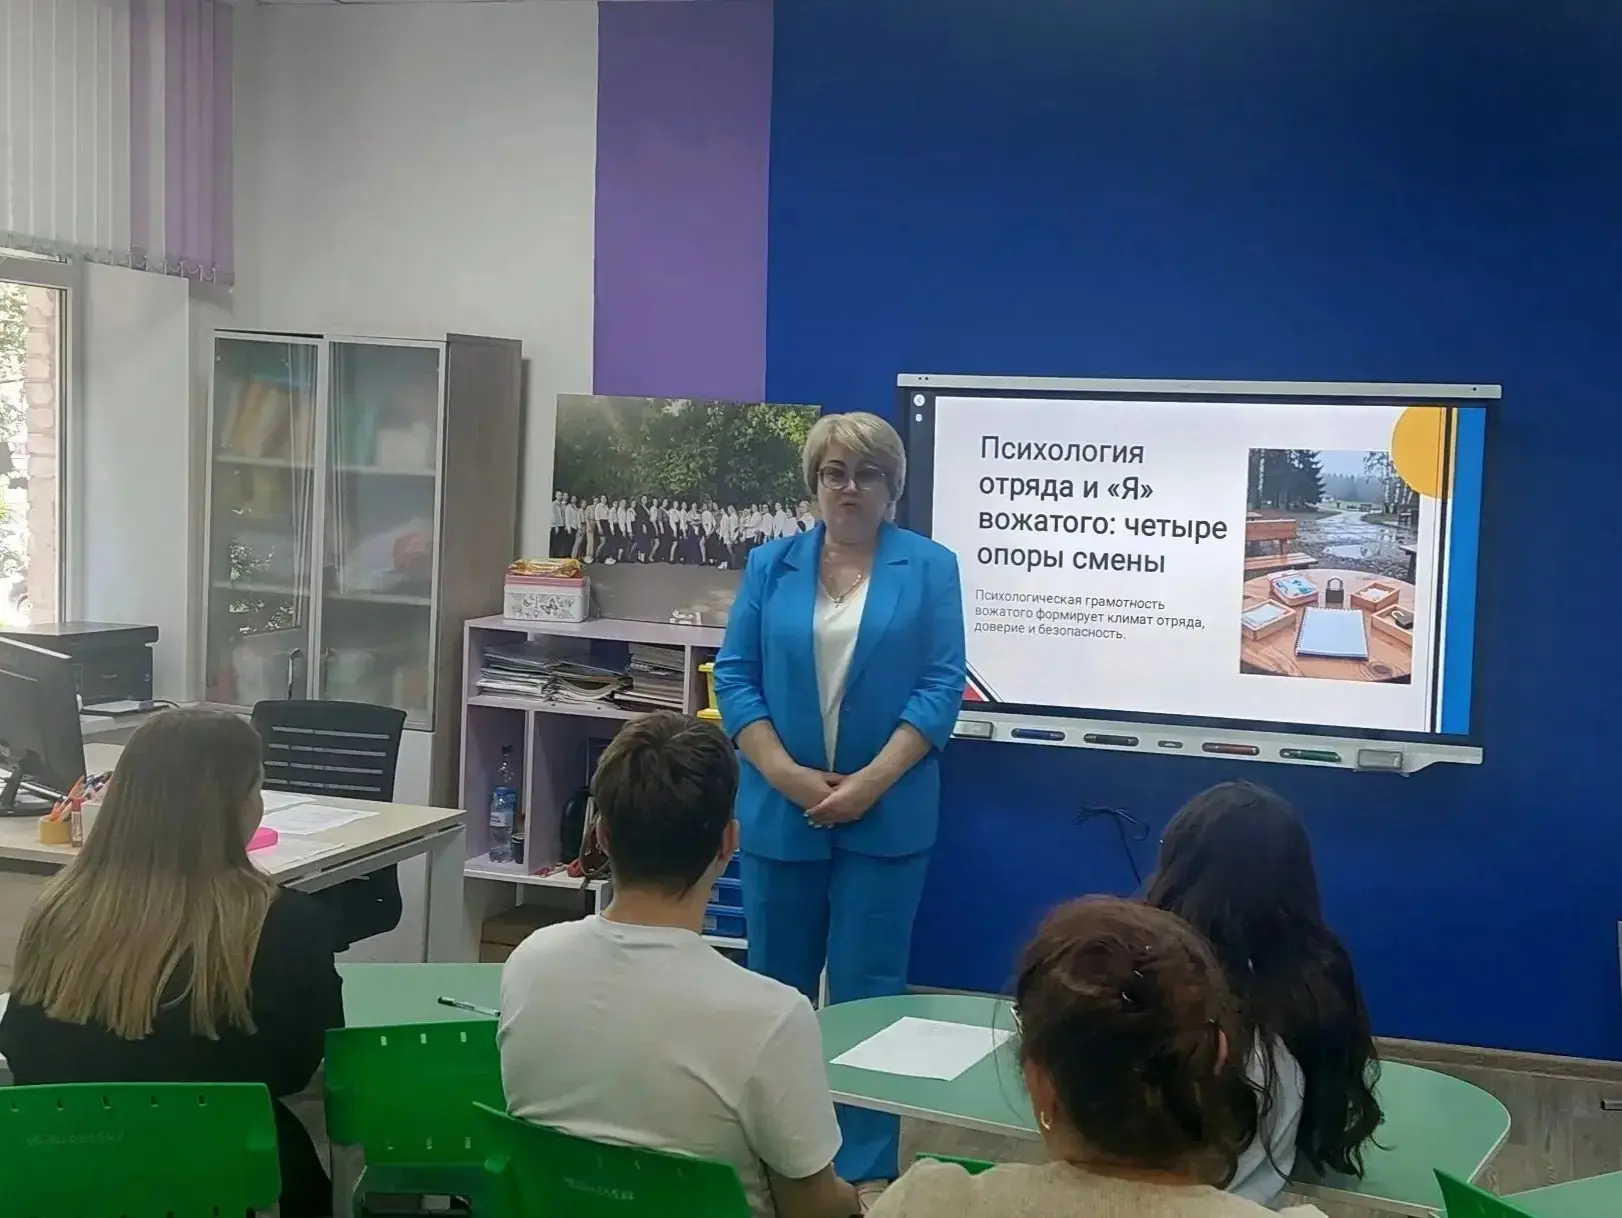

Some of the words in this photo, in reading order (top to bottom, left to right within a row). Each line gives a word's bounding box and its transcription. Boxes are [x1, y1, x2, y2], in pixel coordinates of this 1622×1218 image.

[981, 435, 1145, 464] Психология
[979, 476, 1074, 502] отряда
[1083, 480, 1099, 499] и
[1107, 476, 1154, 501] «Я»
[978, 511, 1116, 535] вожатого:
[1124, 516, 1228, 545] четыре
[977, 546, 1064, 573] опоры
[1072, 550, 1165, 573] смены
[975, 589, 1083, 606] Психологическая
[1085, 596, 1166, 610] грамотность
[973, 622, 1026, 635] доверие
[1028, 625, 1036, 635] и
[1038, 623, 1127, 640] безопасность.
[975, 606, 1034, 619] вожатого
[1035, 607, 1105, 624] формирует
[1107, 614, 1154, 626] климат
[1156, 616, 1206, 630] отряда,
